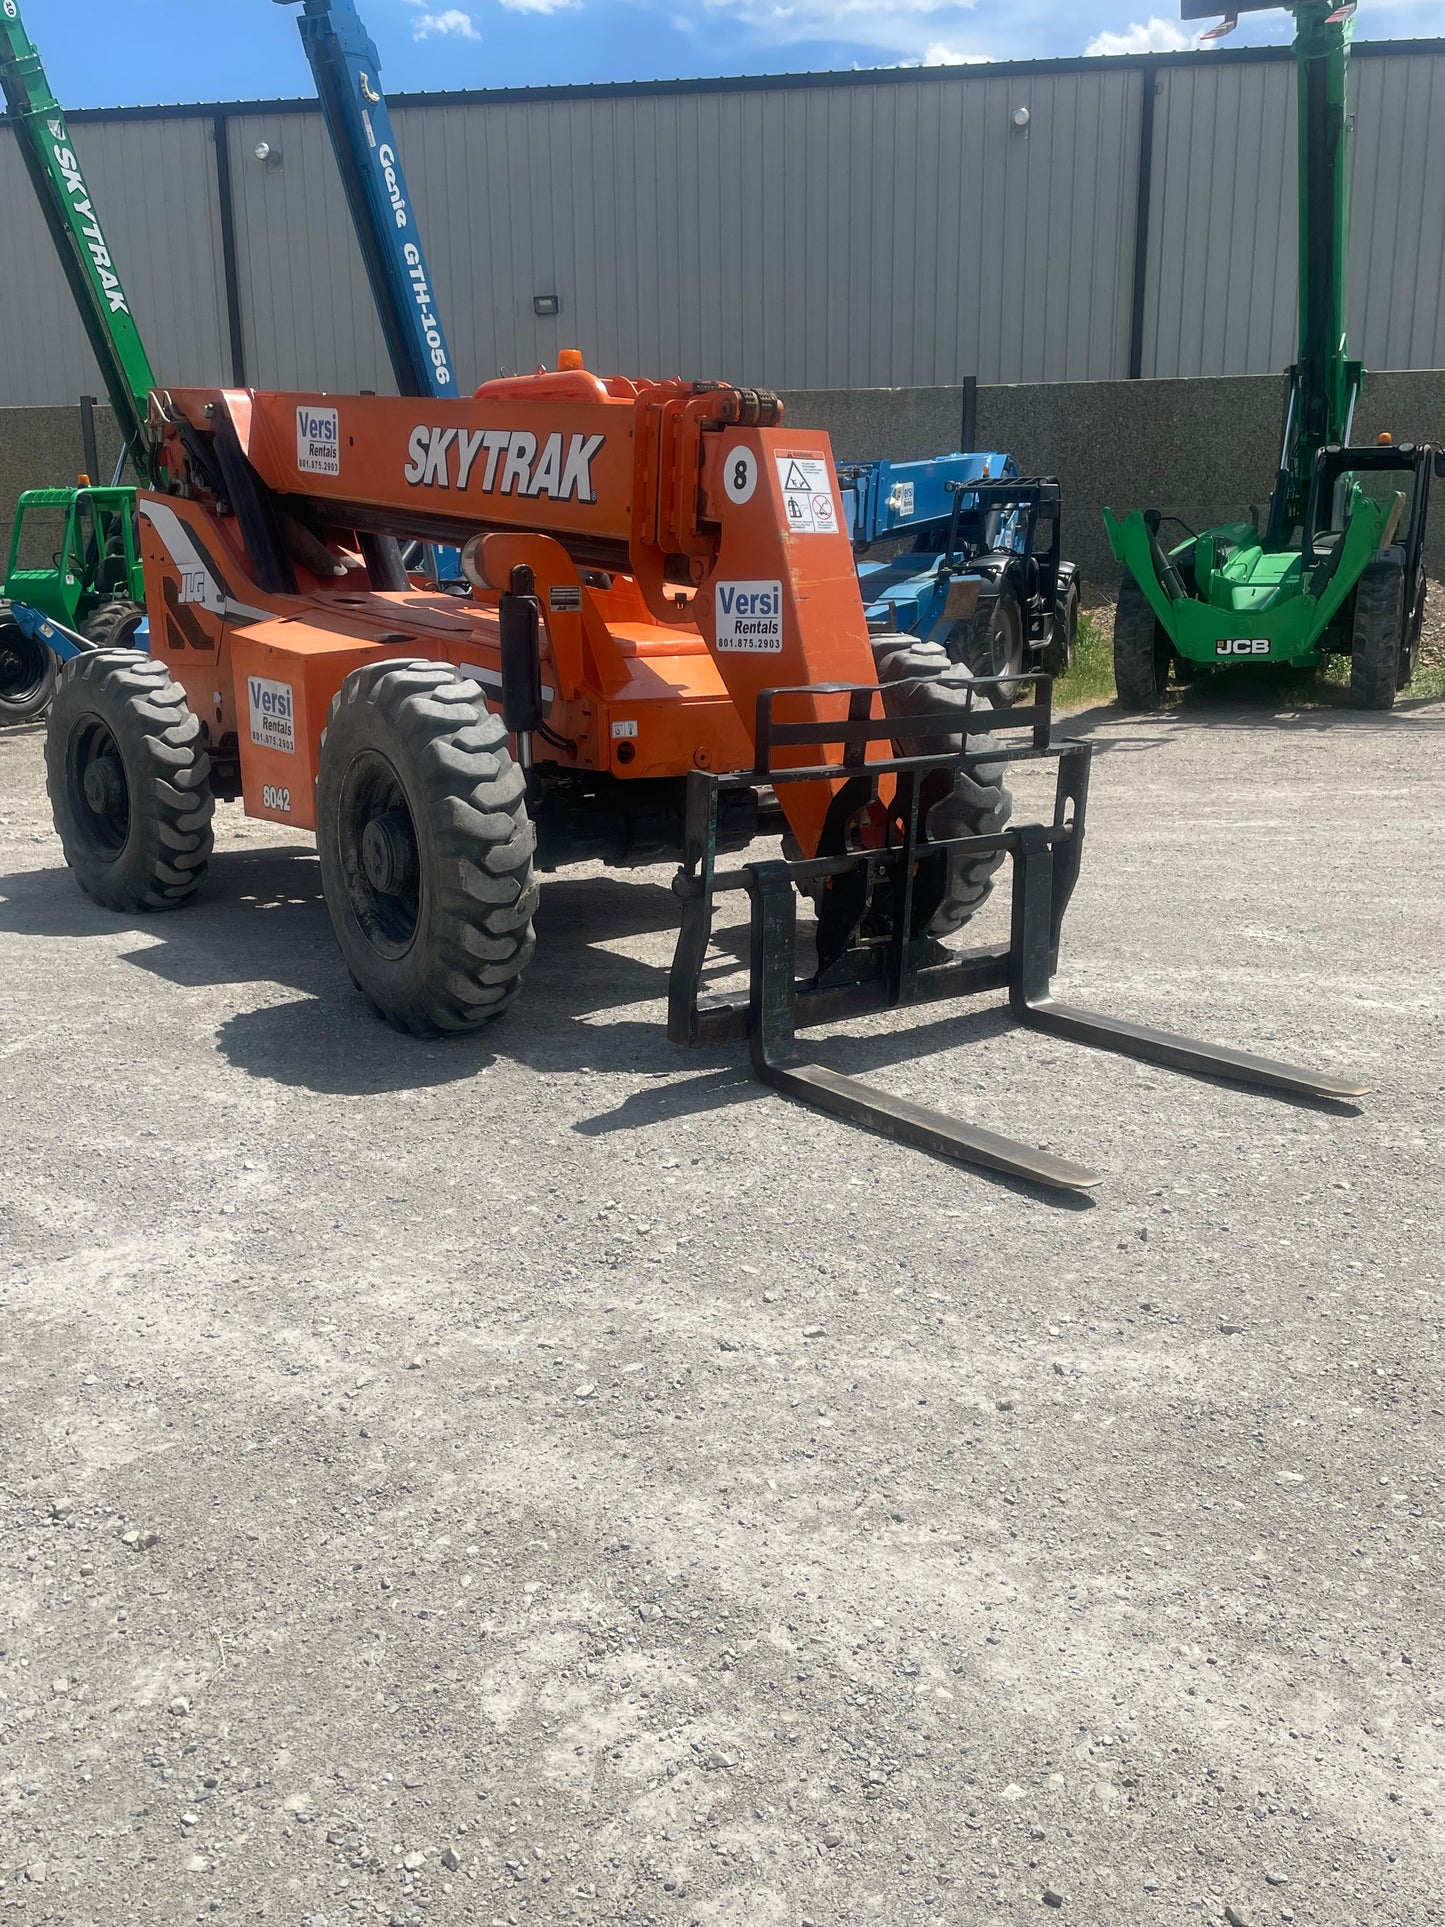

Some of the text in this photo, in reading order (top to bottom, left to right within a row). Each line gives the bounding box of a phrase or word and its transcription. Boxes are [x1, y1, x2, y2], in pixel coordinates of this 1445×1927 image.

[5, 1, 15, 15] 10
[53, 144, 130, 316] SKYTRAK
[379, 143, 451, 385] Genie GTH-1056
[298, 411, 337, 440] Versi
[298, 458, 338, 472] 801.875.2903
[309, 443, 337, 458] Rentals
[403, 423, 606, 504] SKYTRAK
[733, 460, 748, 490] 8
[177, 571, 206, 604] JLG
[718, 586, 779, 615] Versi
[734, 620, 779, 634] Rentals
[718, 637, 780, 649] 801.875.2903
[1216, 639, 1270, 655] JCB
[249, 680, 292, 717] Versi
[252, 730, 294, 751] 801.875.2903
[262, 716, 293, 736] Rentals
[262, 783, 292, 812] 8042
